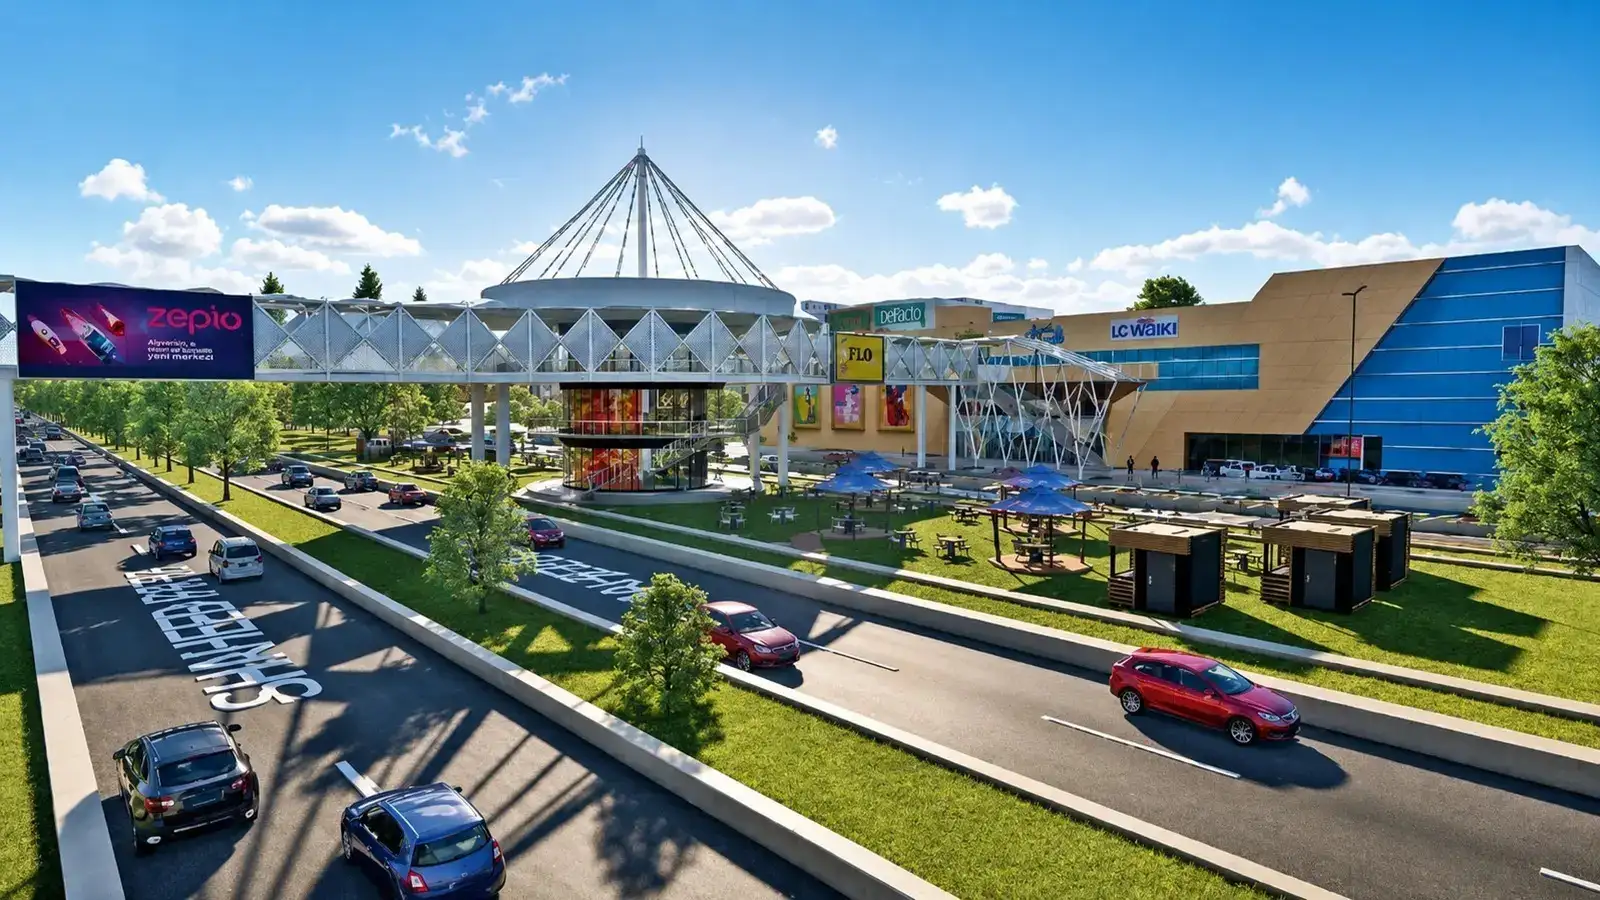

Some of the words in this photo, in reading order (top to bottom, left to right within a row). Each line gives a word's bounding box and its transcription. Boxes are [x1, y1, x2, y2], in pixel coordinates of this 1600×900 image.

[147, 305, 242, 335] zepio
[880, 306, 921, 324] DeFacto
[1112, 325, 1128, 338] LC
[848, 347, 872, 362] FLO
